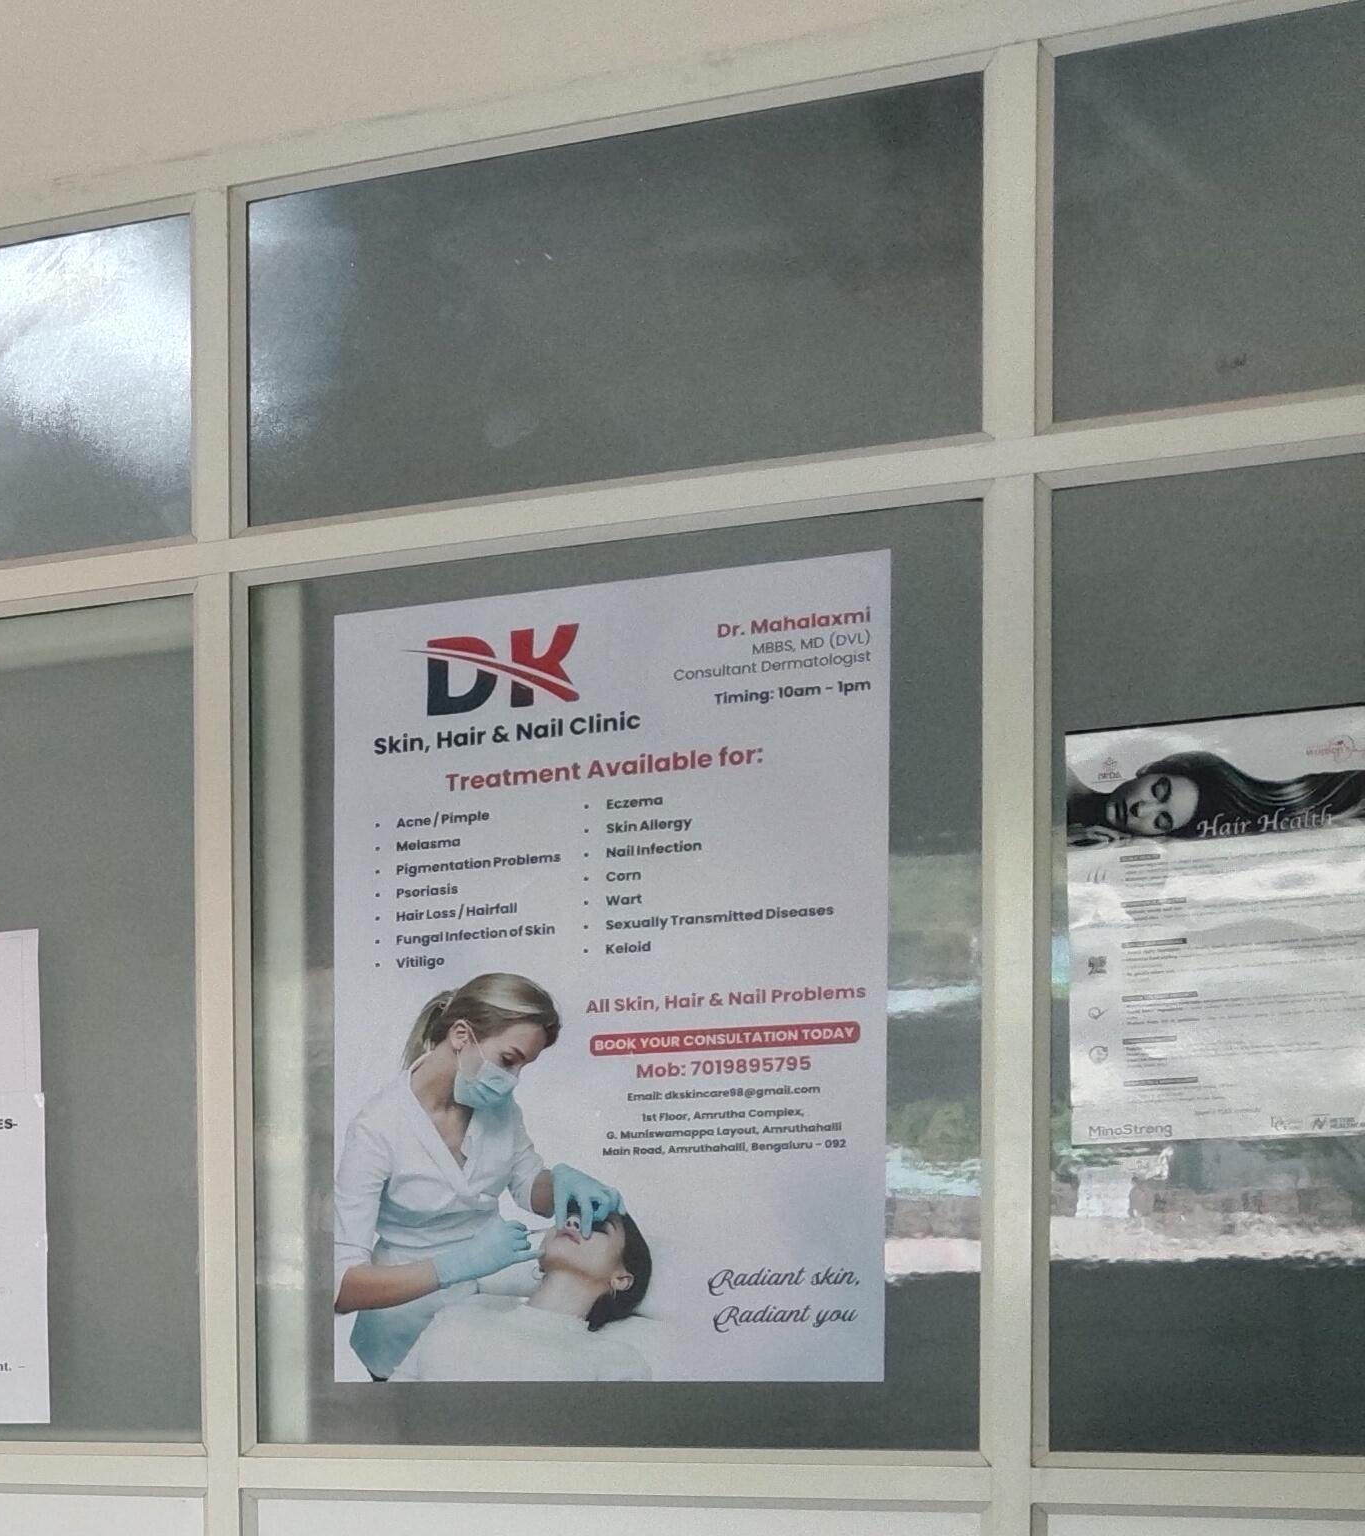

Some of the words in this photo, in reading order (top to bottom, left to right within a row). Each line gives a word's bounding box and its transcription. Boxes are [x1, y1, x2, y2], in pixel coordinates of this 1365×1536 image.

[717, 624, 745, 638] Dr.
[751, 606, 870, 639] Mahalaxmi
[752, 640, 796, 655] MBBS,
[801, 637, 824, 650] MD
[829, 629, 871, 649] (DVL)
[401, 622, 580, 716] DK
[673, 662, 757, 681] Consultant
[757, 647, 871, 672] Dermatologist
[714, 689, 774, 705] Timing:
[779, 686, 821, 698] 10am
[838, 681, 871, 696] 1pm
[374, 733, 430, 755] Skin,
[437, 726, 486, 749] Hair
[492, 725, 509, 743] &
[517, 719, 563, 741] Nail
[569, 711, 640, 735] Clinic
[445, 762, 581, 792] Treatment
[587, 750, 712, 779] Available
[719, 746, 763, 767] for:
[607, 797, 663, 810] Eczema
[396, 817, 431, 828] Acne
[441, 811, 489, 826] Pimple
[606, 821, 637, 834] Skin
[640, 819, 692, 832] Allergy
[1197, 813, 1252, 837] Hair
[1257, 804, 1333, 832] Health
[396, 838, 460, 851] Melasma
[606, 845, 634, 858] Nail
[637, 840, 702, 855] Infection
[396, 858, 491, 877] Pigmentation
[493, 853, 561, 867] Problems
[606, 871, 641, 882] Corn
[396, 883, 458, 899] Psoriasis
[606, 894, 642, 906] Wart
[396, 909, 424, 922] Hair
[426, 909, 456, 919] Loss
[466, 902, 517, 916] Hairfall
[606, 916, 668, 930] Sexually
[670, 909, 763, 925] Transmitted
[766, 906, 834, 919] Diseases
[396, 931, 443, 947] Fungal
[445, 927, 507, 942] Infection
[509, 925, 523, 937] of
[525, 923, 555, 936] Skin
[606, 941, 651, 954] Keloid
[396, 955, 445, 970] Vitiligo
[586, 998, 609, 1013] All
[614, 996, 659, 1012] Skin,
[665, 993, 705, 1009] Hair
[709, 992, 723, 1007] &
[729, 988, 766, 1005] Nail
[771, 985, 866, 1003] Problems
[595, 1038, 636, 1051] BOOK
[640, 1036, 680, 1048] YOUR
[683, 1030, 798, 1046] CONSULTATION
[801, 1027, 854, 1040] TODAY
[637, 1062, 686, 1078] Mob:
[691, 1055, 811, 1076] 7019895795
[642, 1113, 657, 1122] 1st
[659, 1112, 691, 1121] Floor,
[693, 1110, 745, 1120] Amrutha
[748, 1107, 804, 1120] Complex,
[606, 1131, 618, 1140] G.
[620, 1129, 714, 1139] Muniswamappa
[717, 1126, 759, 1138] Layout,
[762, 1122, 842, 1134] Amruthahalli
[603, 1147, 630, 1156] Main
[633, 1145, 665, 1155] Road,
[668, 1142, 748, 1154] Amruthahalli,
[751, 1140, 813, 1153] Bengaluru
[824, 1139, 846, 1148] 092
[707, 1267, 805, 1296] Radiant
[713, 1305, 811, 1333] Radiant
[812, 1308, 858, 1328] you
